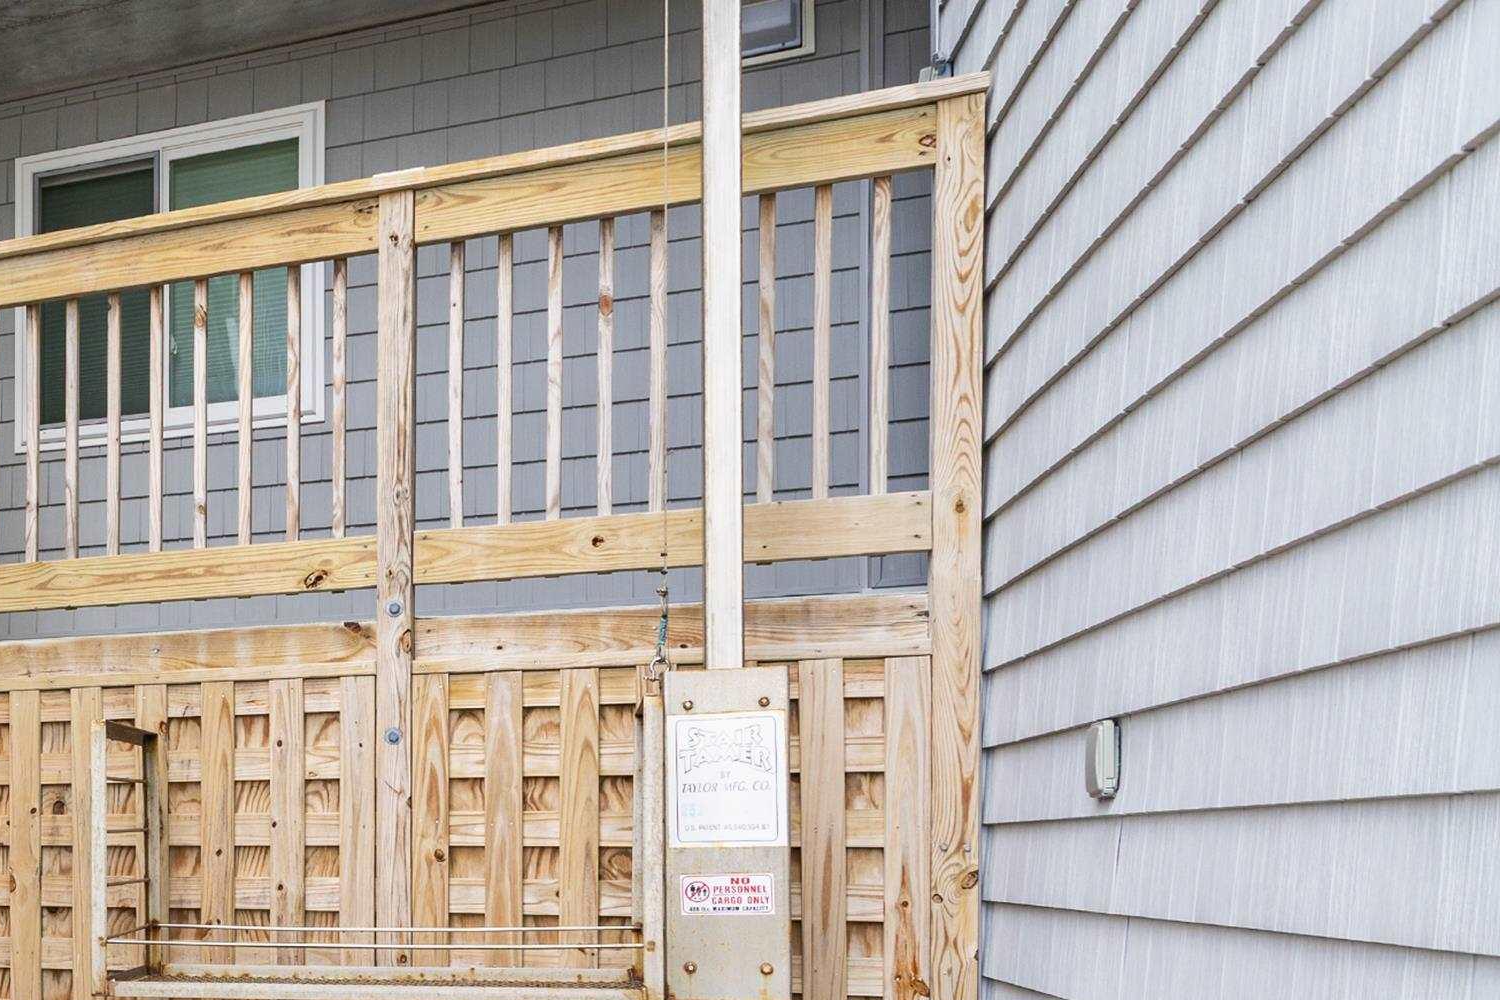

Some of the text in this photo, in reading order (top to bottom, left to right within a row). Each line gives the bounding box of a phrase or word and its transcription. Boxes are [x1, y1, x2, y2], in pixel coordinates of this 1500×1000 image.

[687, 724, 763, 748] STAIR
[678, 746, 773, 774] TAMER
[720, 771, 731, 779] BY
[682, 782, 718, 793] TAYLOR
[730, 877, 750, 885] NO
[713, 885, 767, 894] PERSONNEL
[711, 895, 770, 905] CARGO ONLY
